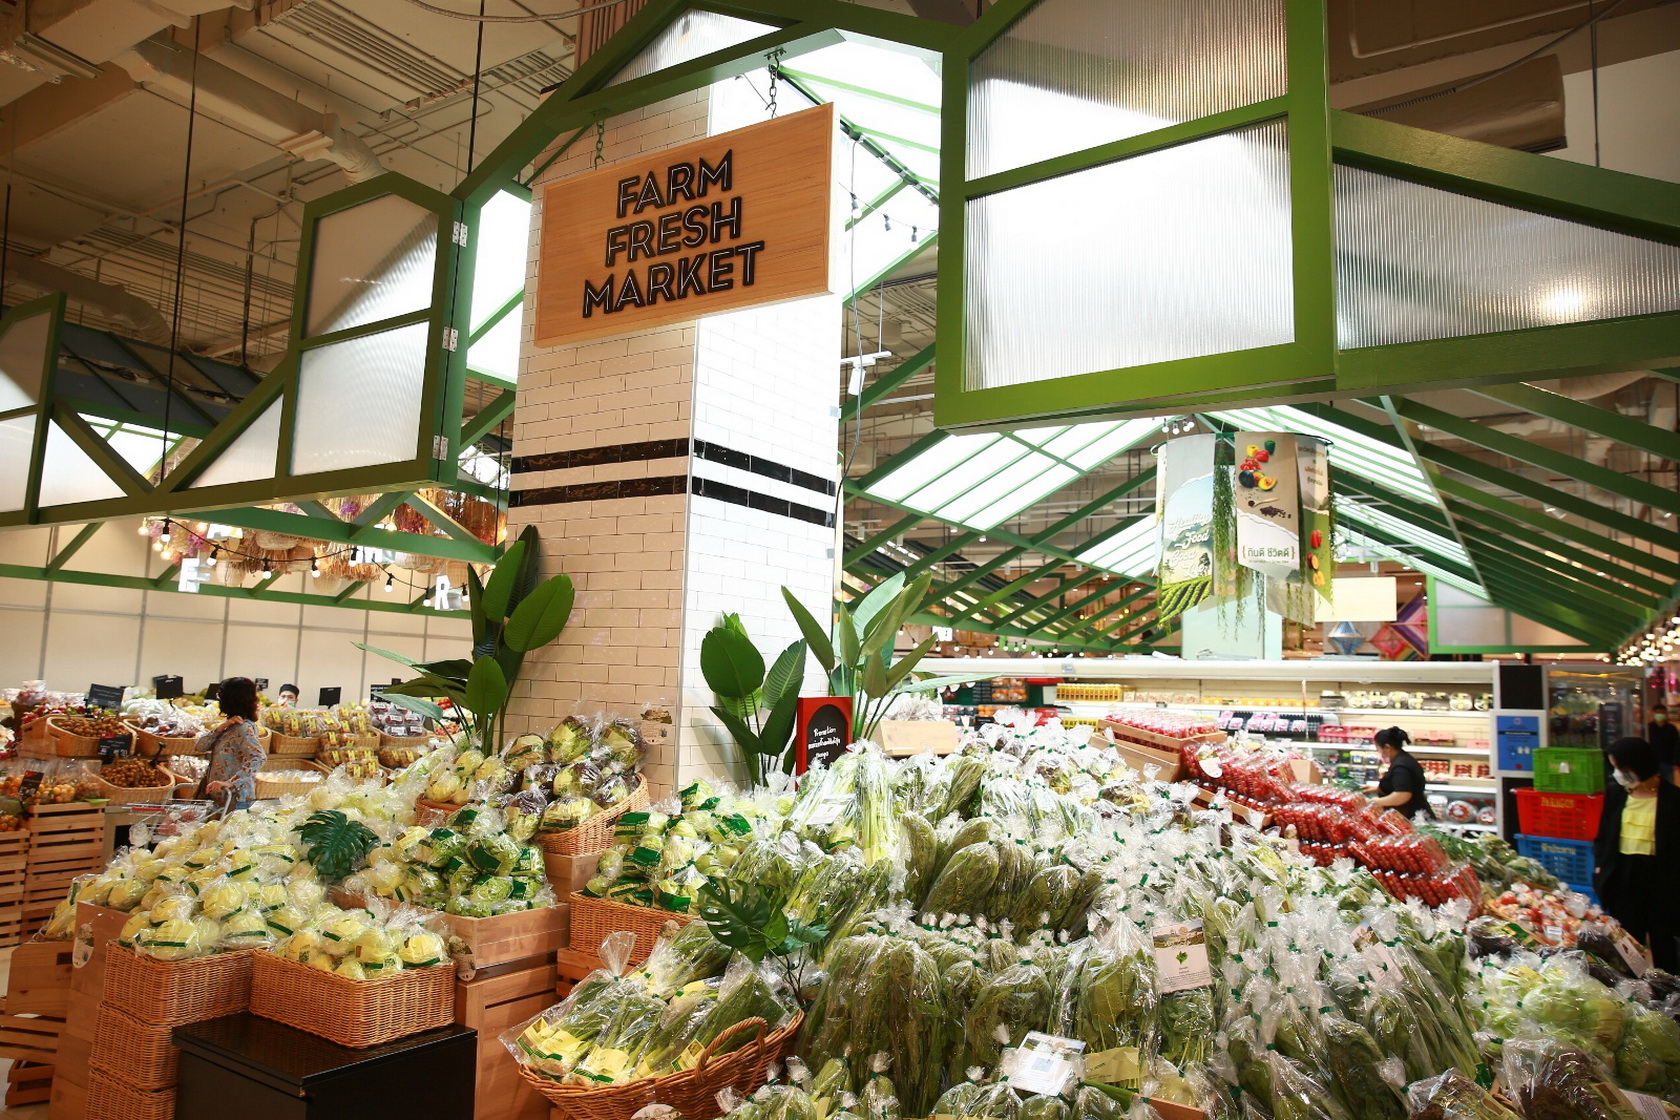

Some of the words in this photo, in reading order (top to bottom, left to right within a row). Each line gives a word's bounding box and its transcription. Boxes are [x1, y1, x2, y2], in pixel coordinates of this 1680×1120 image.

[616, 149, 733, 218] FARM
[605, 196, 742, 267] FRESH
[582, 241, 764, 318] MARKET
[1174, 529, 1211, 550] Food
